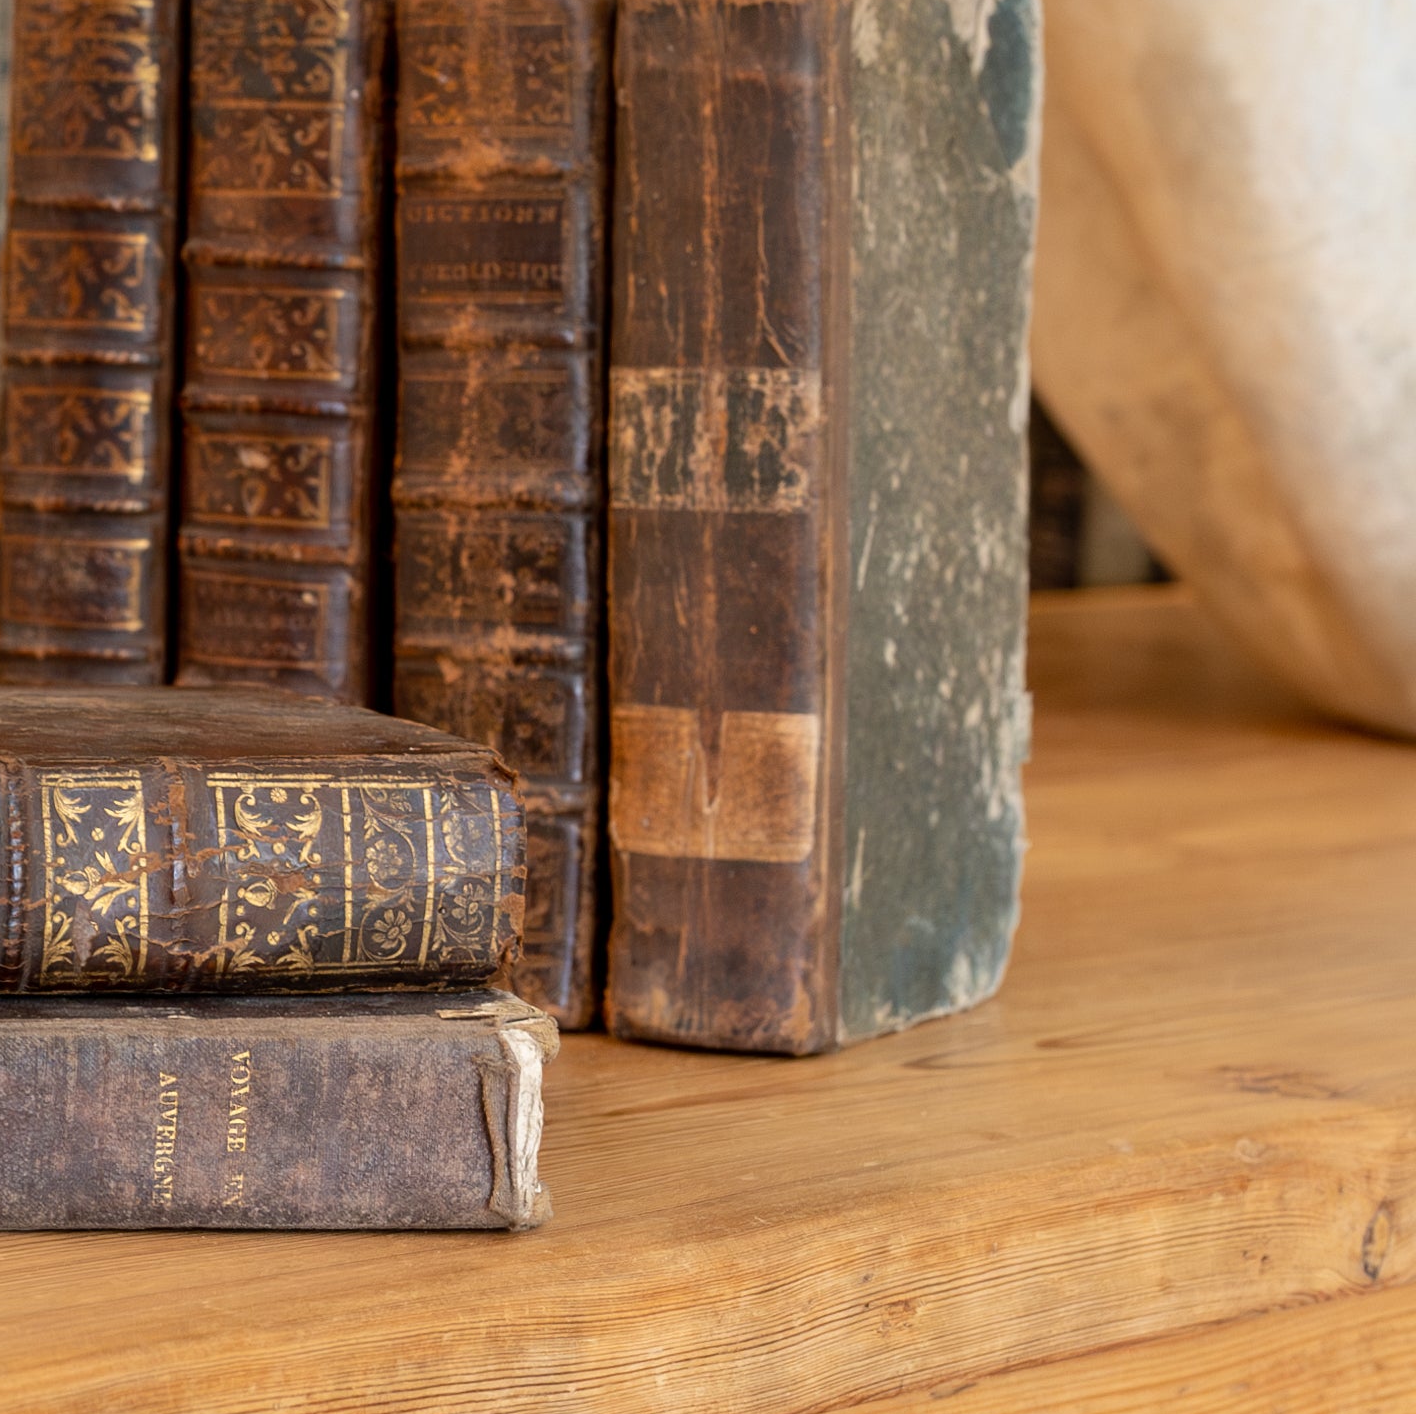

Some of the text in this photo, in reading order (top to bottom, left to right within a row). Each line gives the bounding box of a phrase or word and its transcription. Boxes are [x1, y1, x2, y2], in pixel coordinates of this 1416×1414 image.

[152, 1072, 179, 1207] AUVERGNE
[222, 1050, 251, 1207] VOYAGE EN
